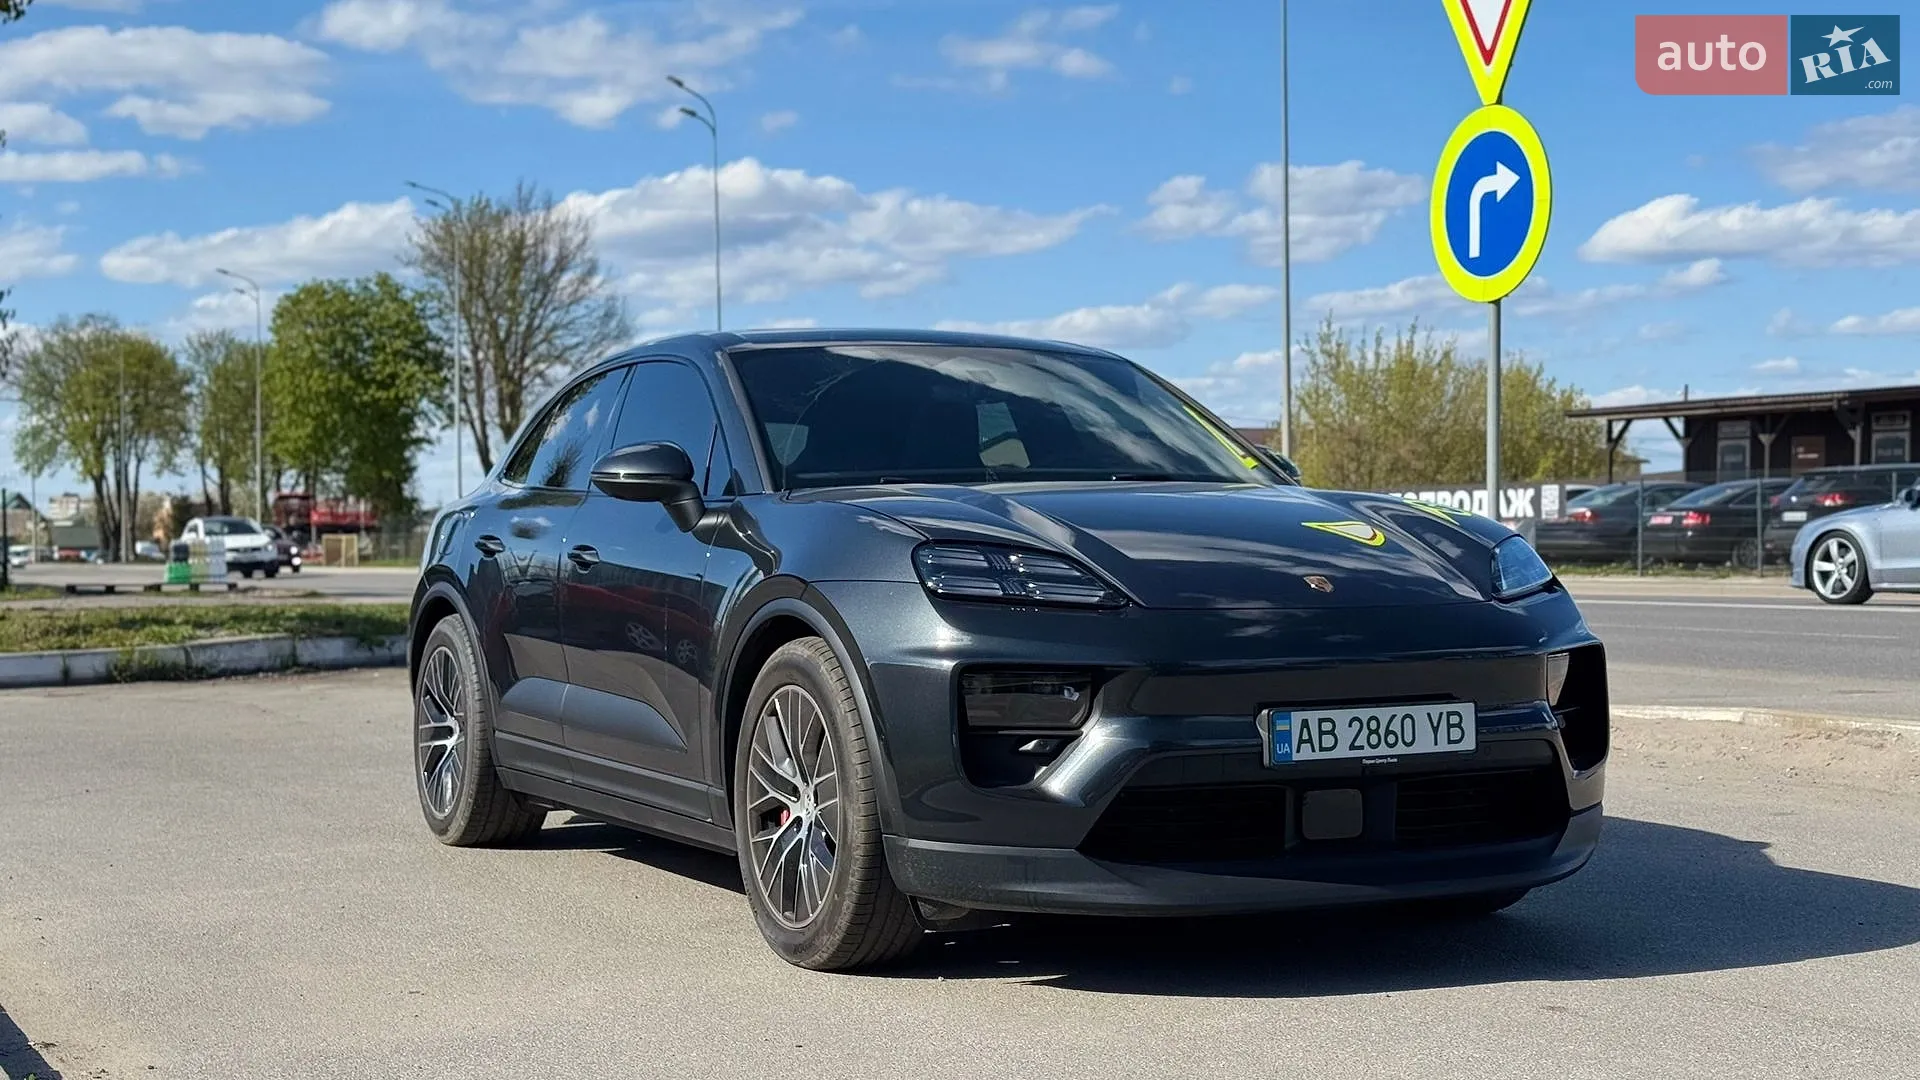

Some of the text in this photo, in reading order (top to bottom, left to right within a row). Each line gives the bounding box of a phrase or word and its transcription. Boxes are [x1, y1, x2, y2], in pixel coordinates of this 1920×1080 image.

[1296, 710, 1465, 754] AB 2860 YB
[1276, 743, 1291, 754] UA
